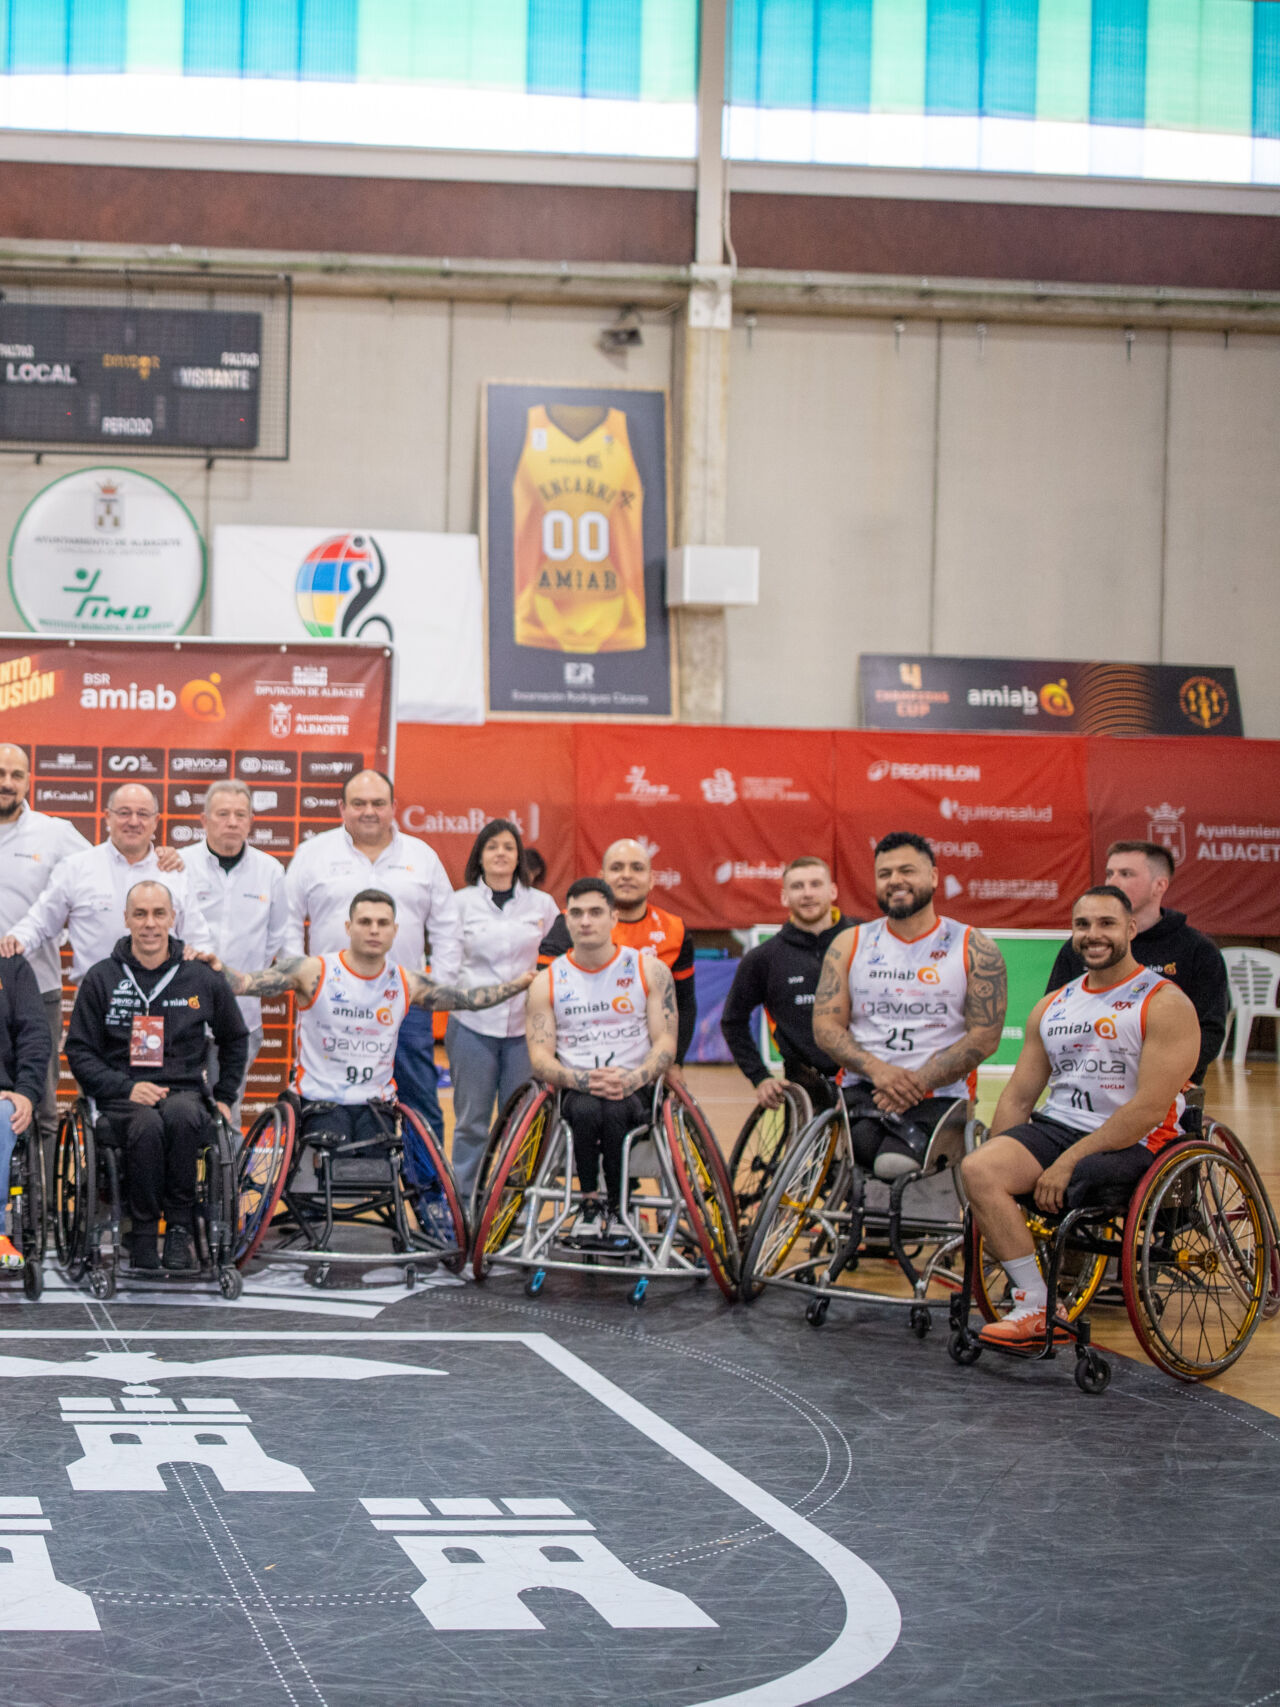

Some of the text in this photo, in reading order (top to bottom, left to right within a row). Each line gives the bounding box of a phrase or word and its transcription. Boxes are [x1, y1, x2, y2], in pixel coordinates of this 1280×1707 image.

[6, 362, 78, 384] LOCAL
[180, 366, 250, 390] VISITANTE
[101, 416, 153, 437] PERIODO
[542, 509, 611, 562] 00
[537, 568, 618, 592] AMIAB
[83, 673, 111, 686] BSR
[80, 683, 177, 711] amiab
[321, 687, 365, 699] ALBACETE
[967, 685, 1038, 707] amiab
[295, 723, 349, 736] ALBACETE
[890, 762, 982, 782] DECATHLON
[402, 805, 524, 835] CaixaBk
[1196, 823, 1280, 841] Ayuntamien
[1198, 843, 1280, 862] ALBACET
[869, 968, 916, 981] amiab
[332, 1006, 374, 1020] amiab
[564, 999, 611, 1016] amiab
[861, 1002, 948, 1017] gaviota
[1112, 1000, 1135, 1011] RGK
[1047, 1022, 1092, 1037] amiab
[885, 1028, 916, 1051] 25
[1051, 1058, 1126, 1077] gaviota
